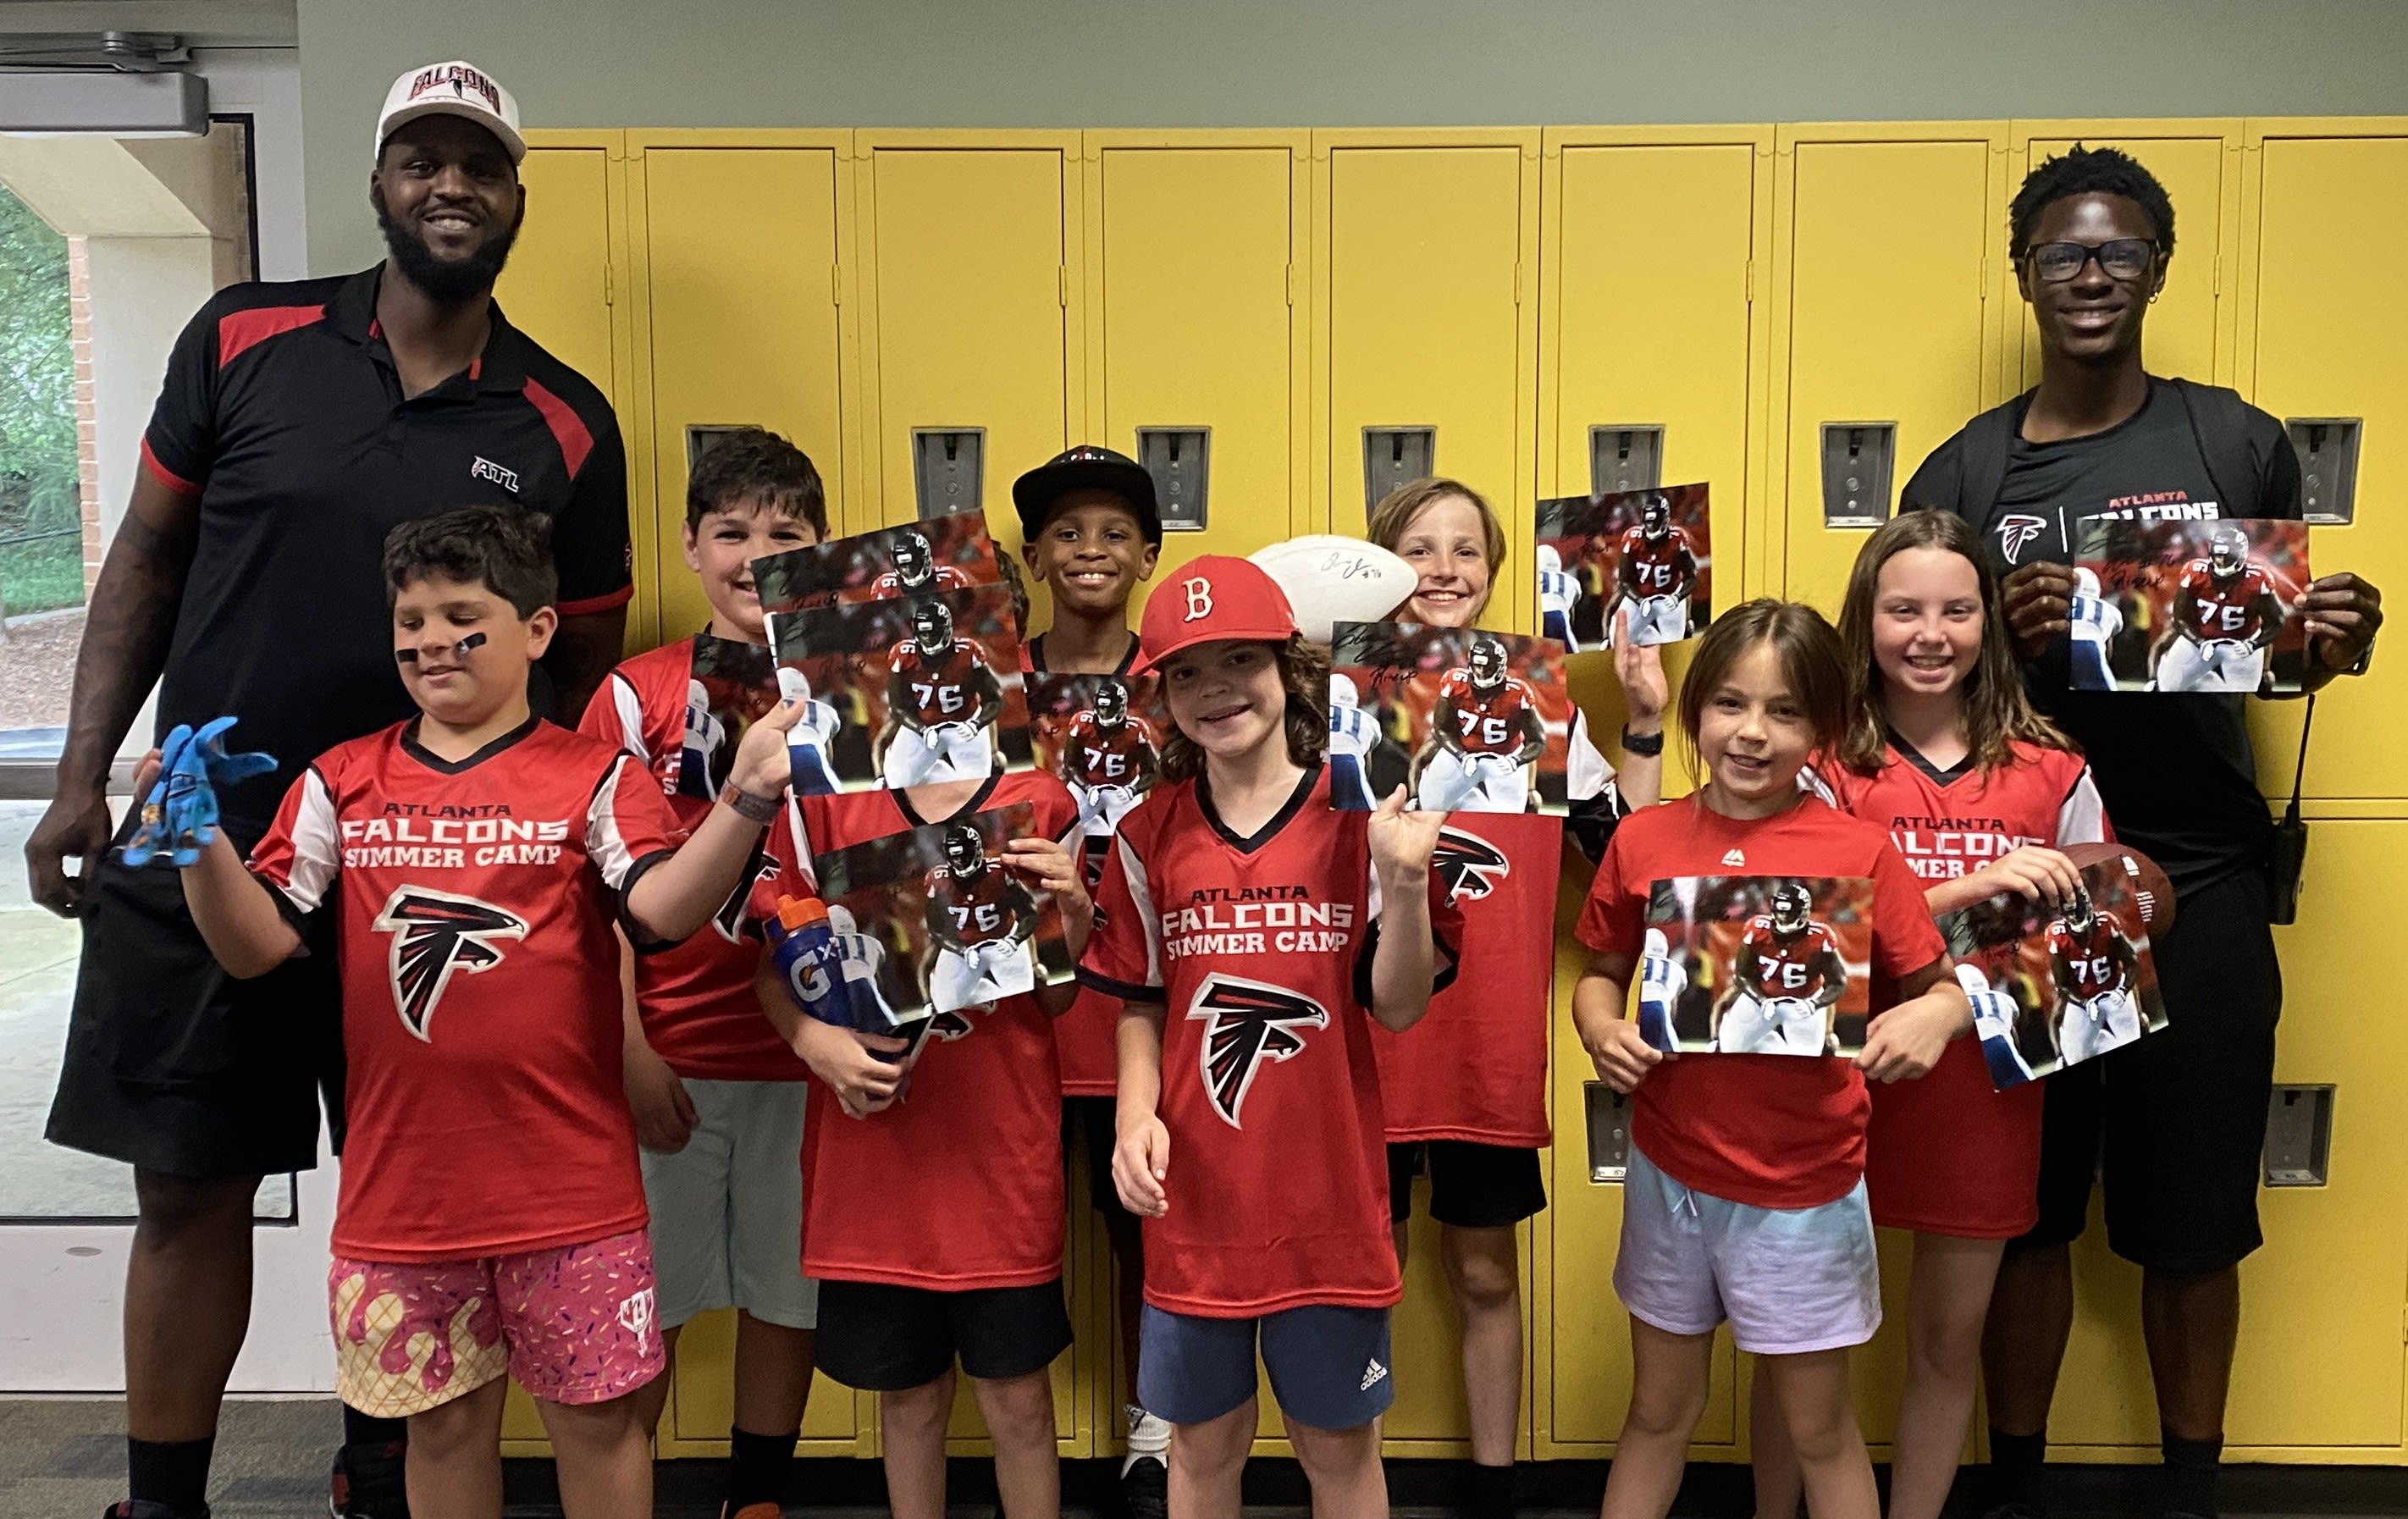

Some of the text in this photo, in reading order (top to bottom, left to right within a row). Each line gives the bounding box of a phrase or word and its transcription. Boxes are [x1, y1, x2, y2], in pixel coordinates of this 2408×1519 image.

[407, 65, 501, 116] FALCONS
[472, 456, 519, 493] ATL
[2109, 490, 2188, 508] ATLANTA
[1636, 562, 1672, 588] 76
[1183, 577, 1214, 622] B
[2197, 599, 2245, 631] 76
[911, 682, 964, 714] 76
[1457, 709, 1508, 745] 76
[1084, 747, 1125, 777] 76
[384, 803, 512, 818] ATLANTA
[1892, 816, 2006, 831] ATLANTA
[341, 818, 569, 844] FALCONS
[345, 843, 561, 868] SUMMER CAMP
[1192, 886, 1309, 903] ATLANTA
[947, 903, 1001, 932] 76
[1162, 902, 1354, 937] FALCONS
[1166, 931, 1349, 961] SUMMER CAMP
[1759, 955, 1807, 990] 76
[2069, 956, 2112, 984] 76
[1361, 1367, 1388, 1391] adidas
